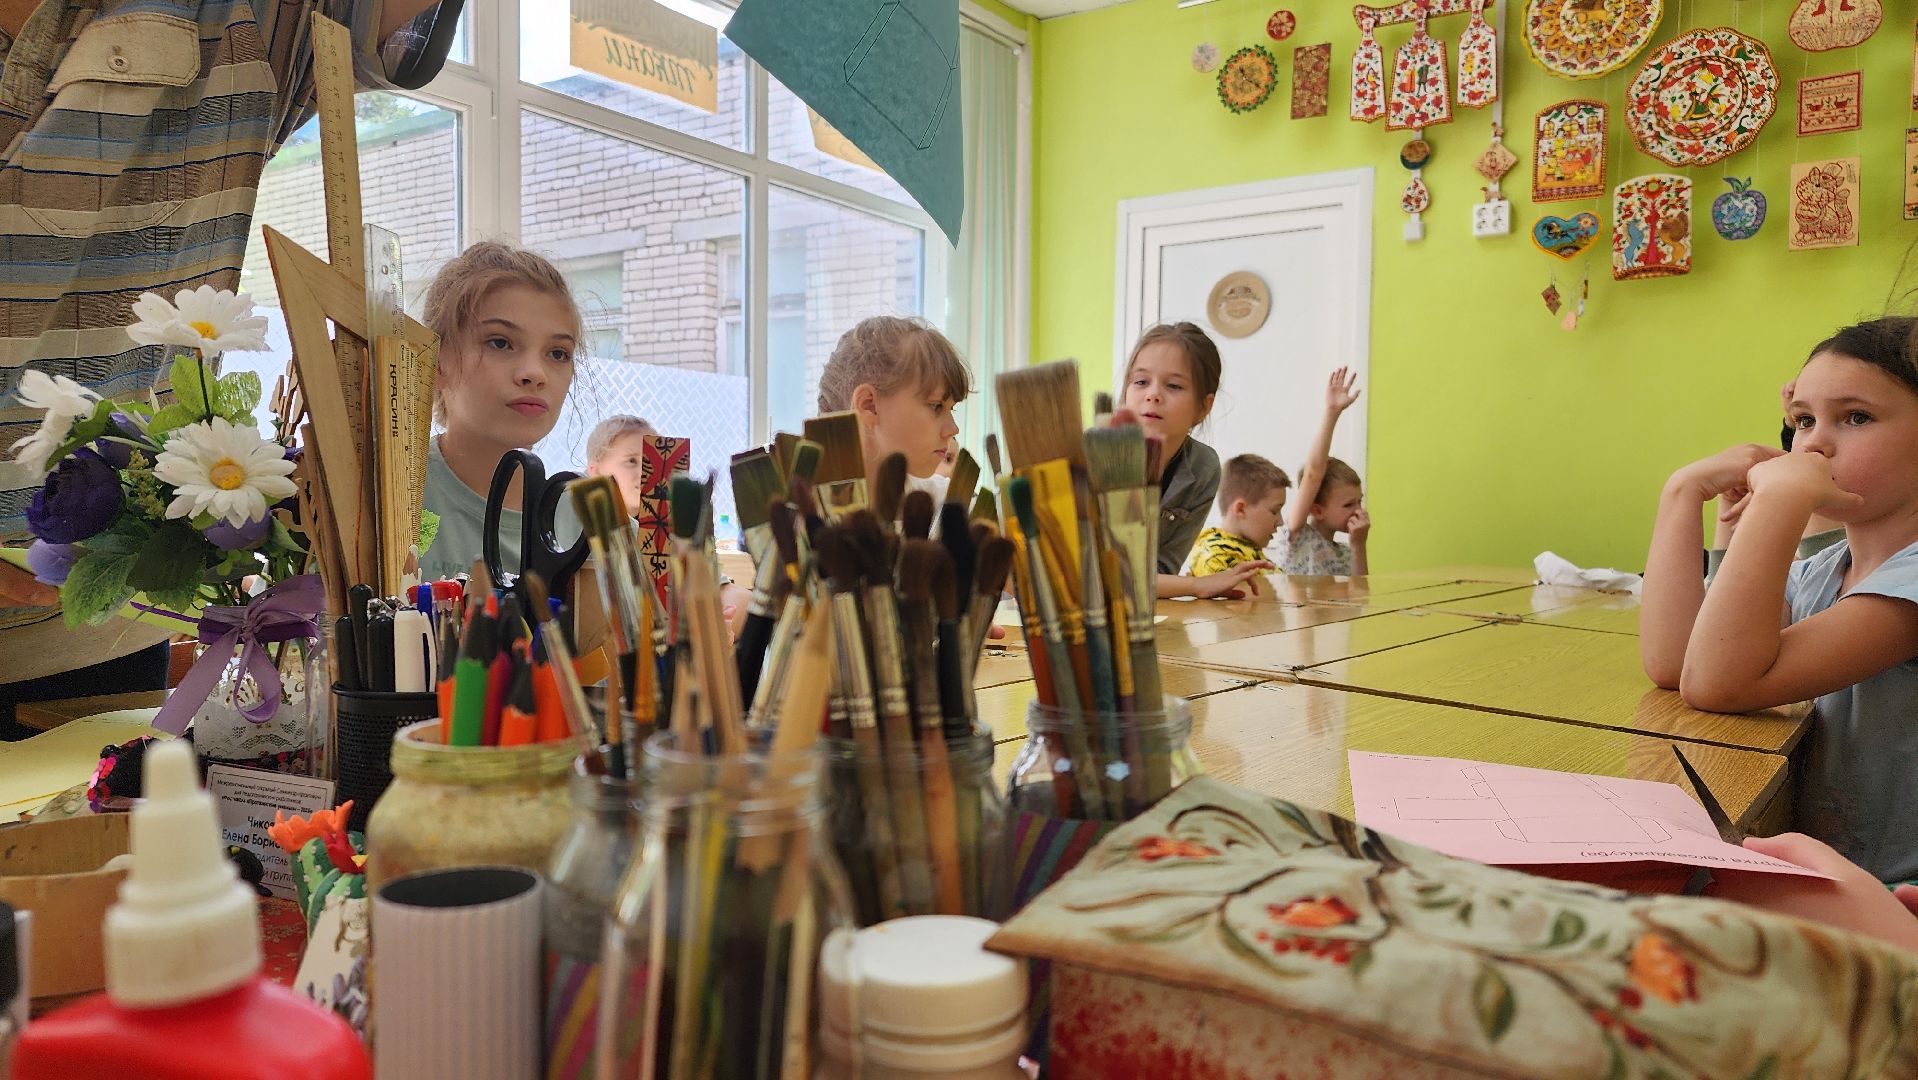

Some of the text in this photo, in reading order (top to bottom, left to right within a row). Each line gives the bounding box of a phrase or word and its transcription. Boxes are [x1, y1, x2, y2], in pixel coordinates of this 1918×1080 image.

[389, 363, 399, 430] КРАСИН
[222, 828, 250, 844] Елена
[252, 833, 283, 849] Борис
[256, 853, 289, 866] одитель
